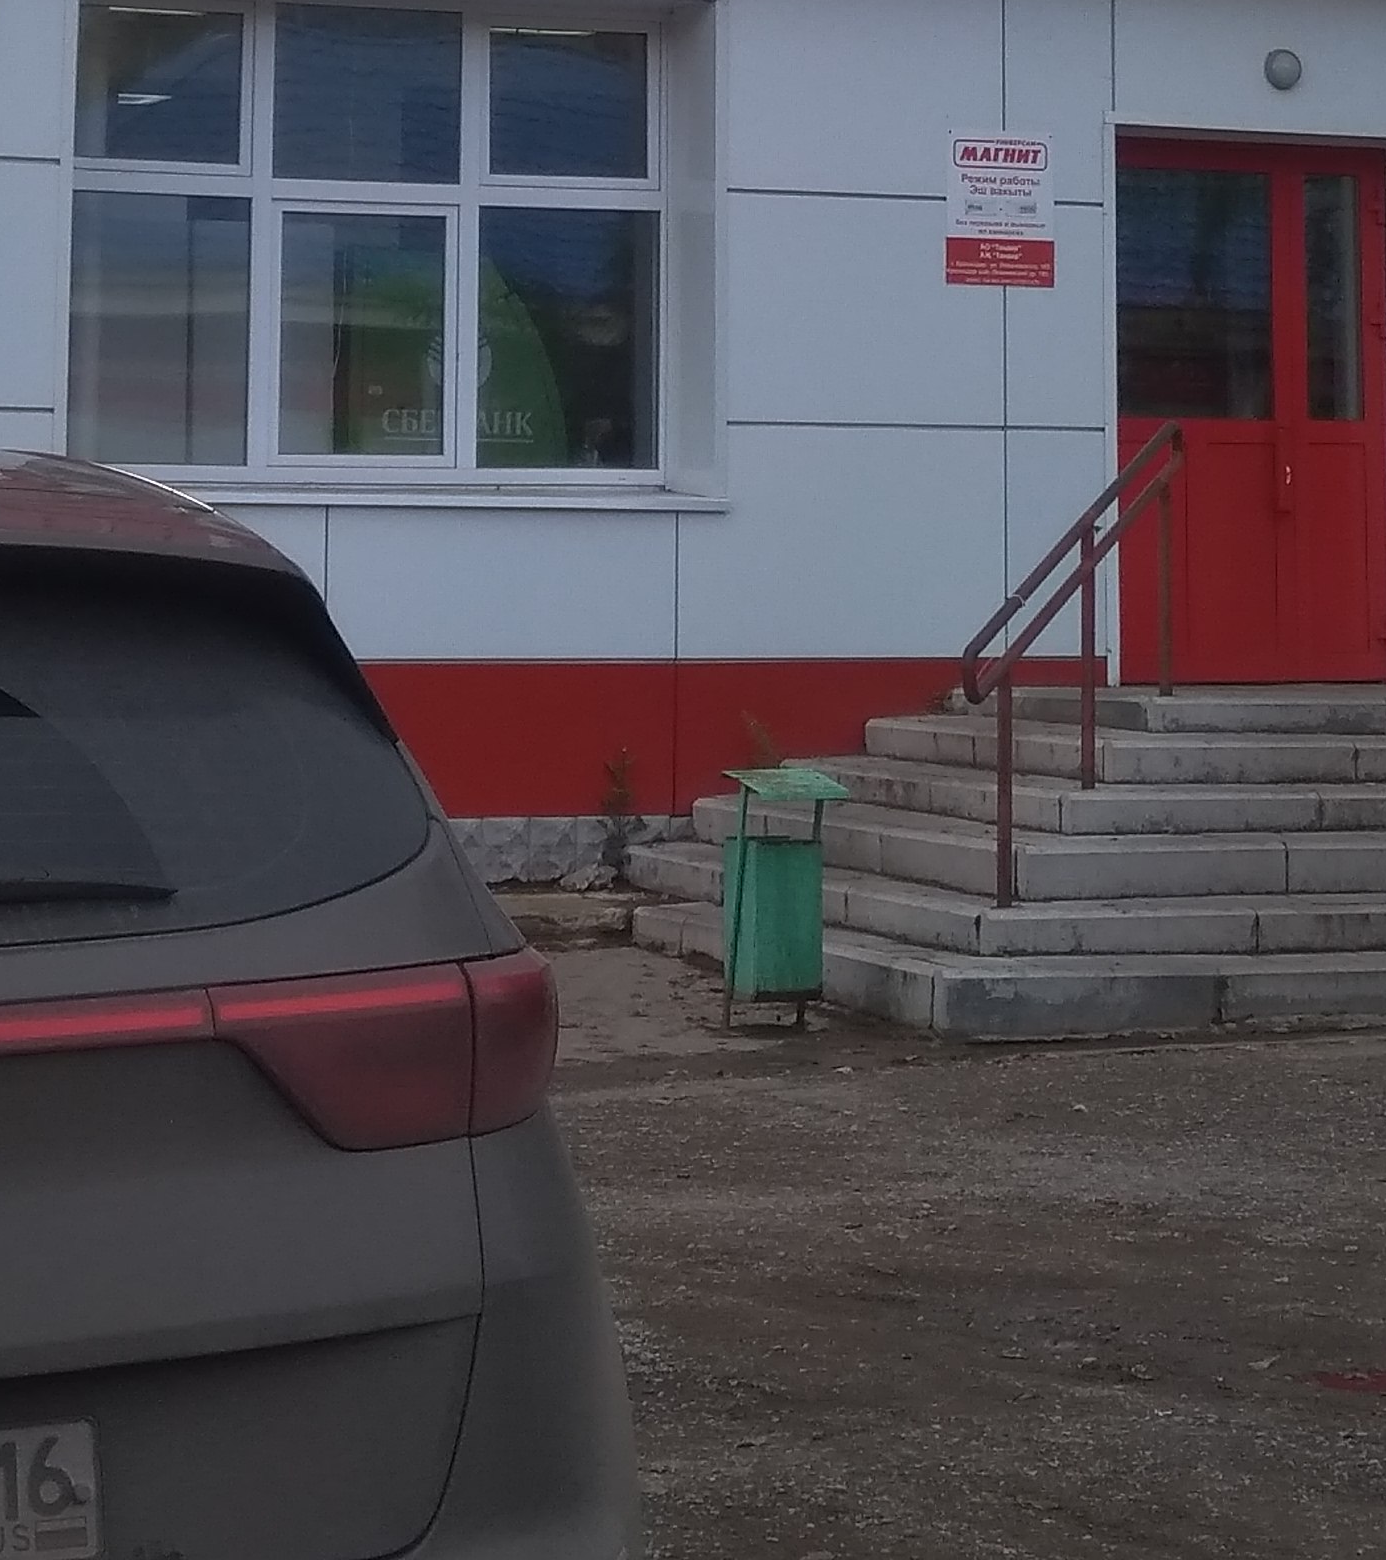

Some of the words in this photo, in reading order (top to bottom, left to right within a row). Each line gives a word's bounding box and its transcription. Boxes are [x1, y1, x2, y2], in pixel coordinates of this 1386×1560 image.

[960, 146, 1042, 165] МАГНИТ
[961, 173, 997, 185] Режим
[382, 407, 533, 437] СБЕАНК
